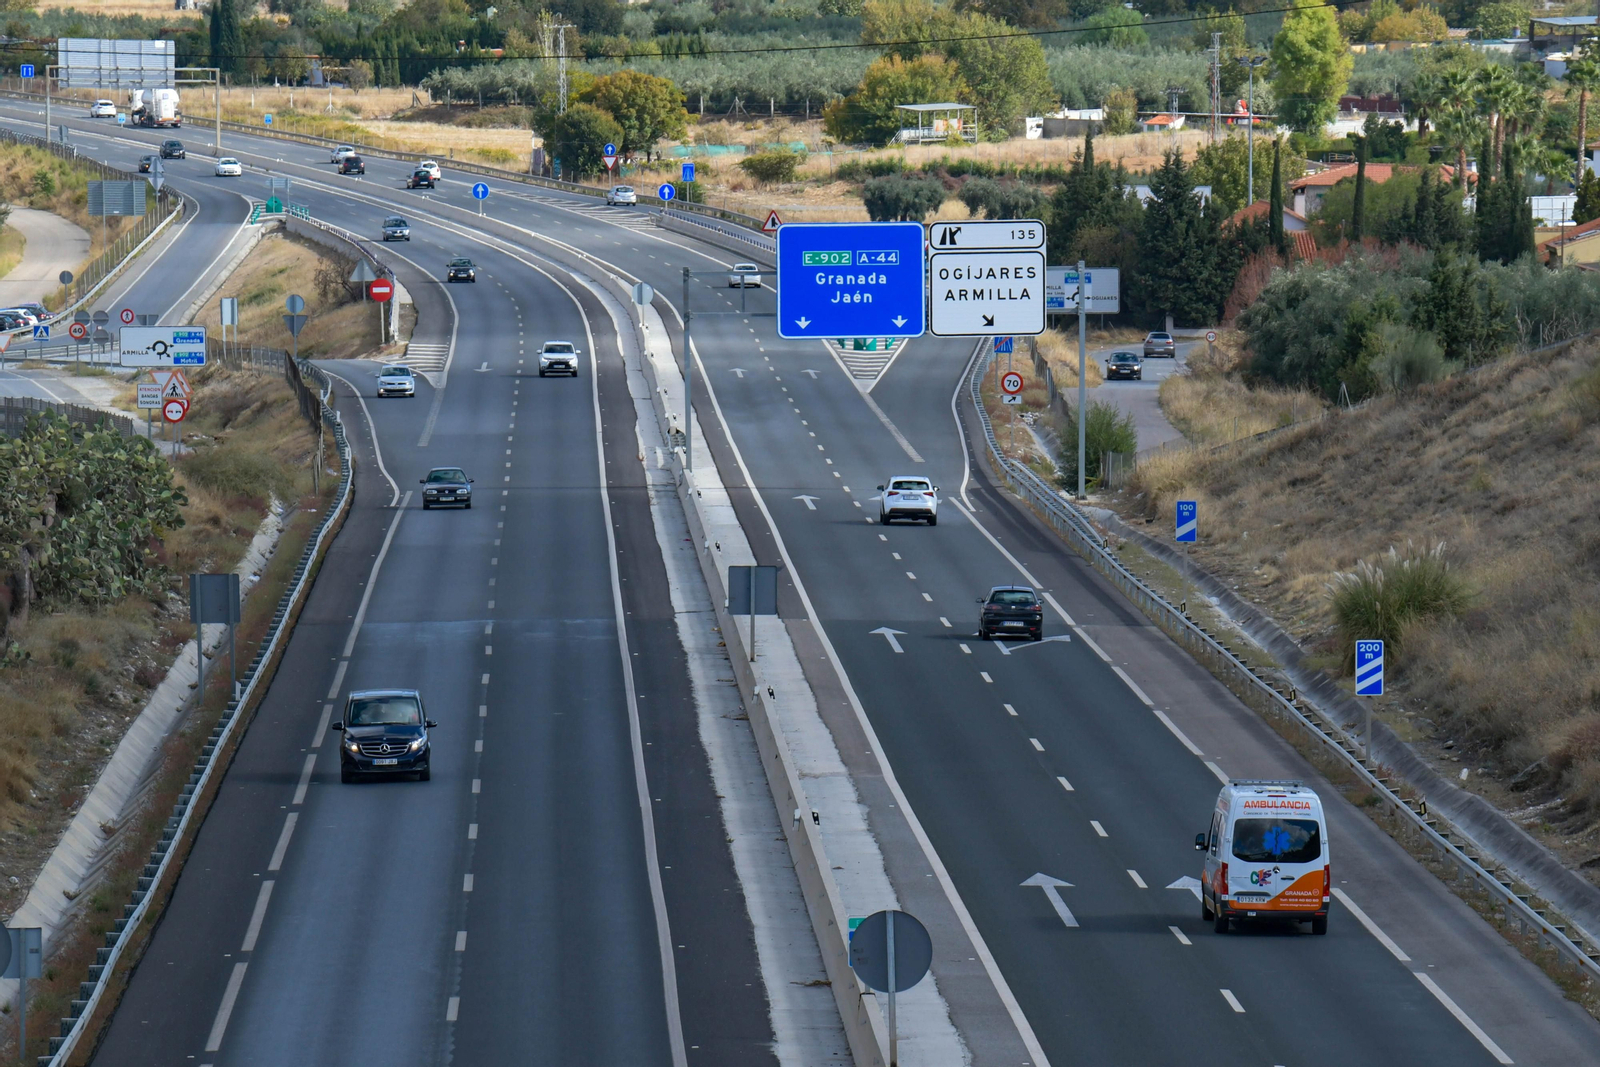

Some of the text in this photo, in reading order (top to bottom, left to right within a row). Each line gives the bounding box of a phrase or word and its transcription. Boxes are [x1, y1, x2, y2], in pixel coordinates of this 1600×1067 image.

[1011, 230, 1036, 240] 135
[805, 253, 896, 263] E-902 A-44
[939, 265, 1036, 280] OGÍJARES
[816, 272, 887, 285] Granada
[831, 290, 873, 303] Jaén
[944, 288, 1031, 301] ARMILLA
[1360, 644, 1380, 652] 200
[1244, 800, 1311, 810] AMBULANCIA
